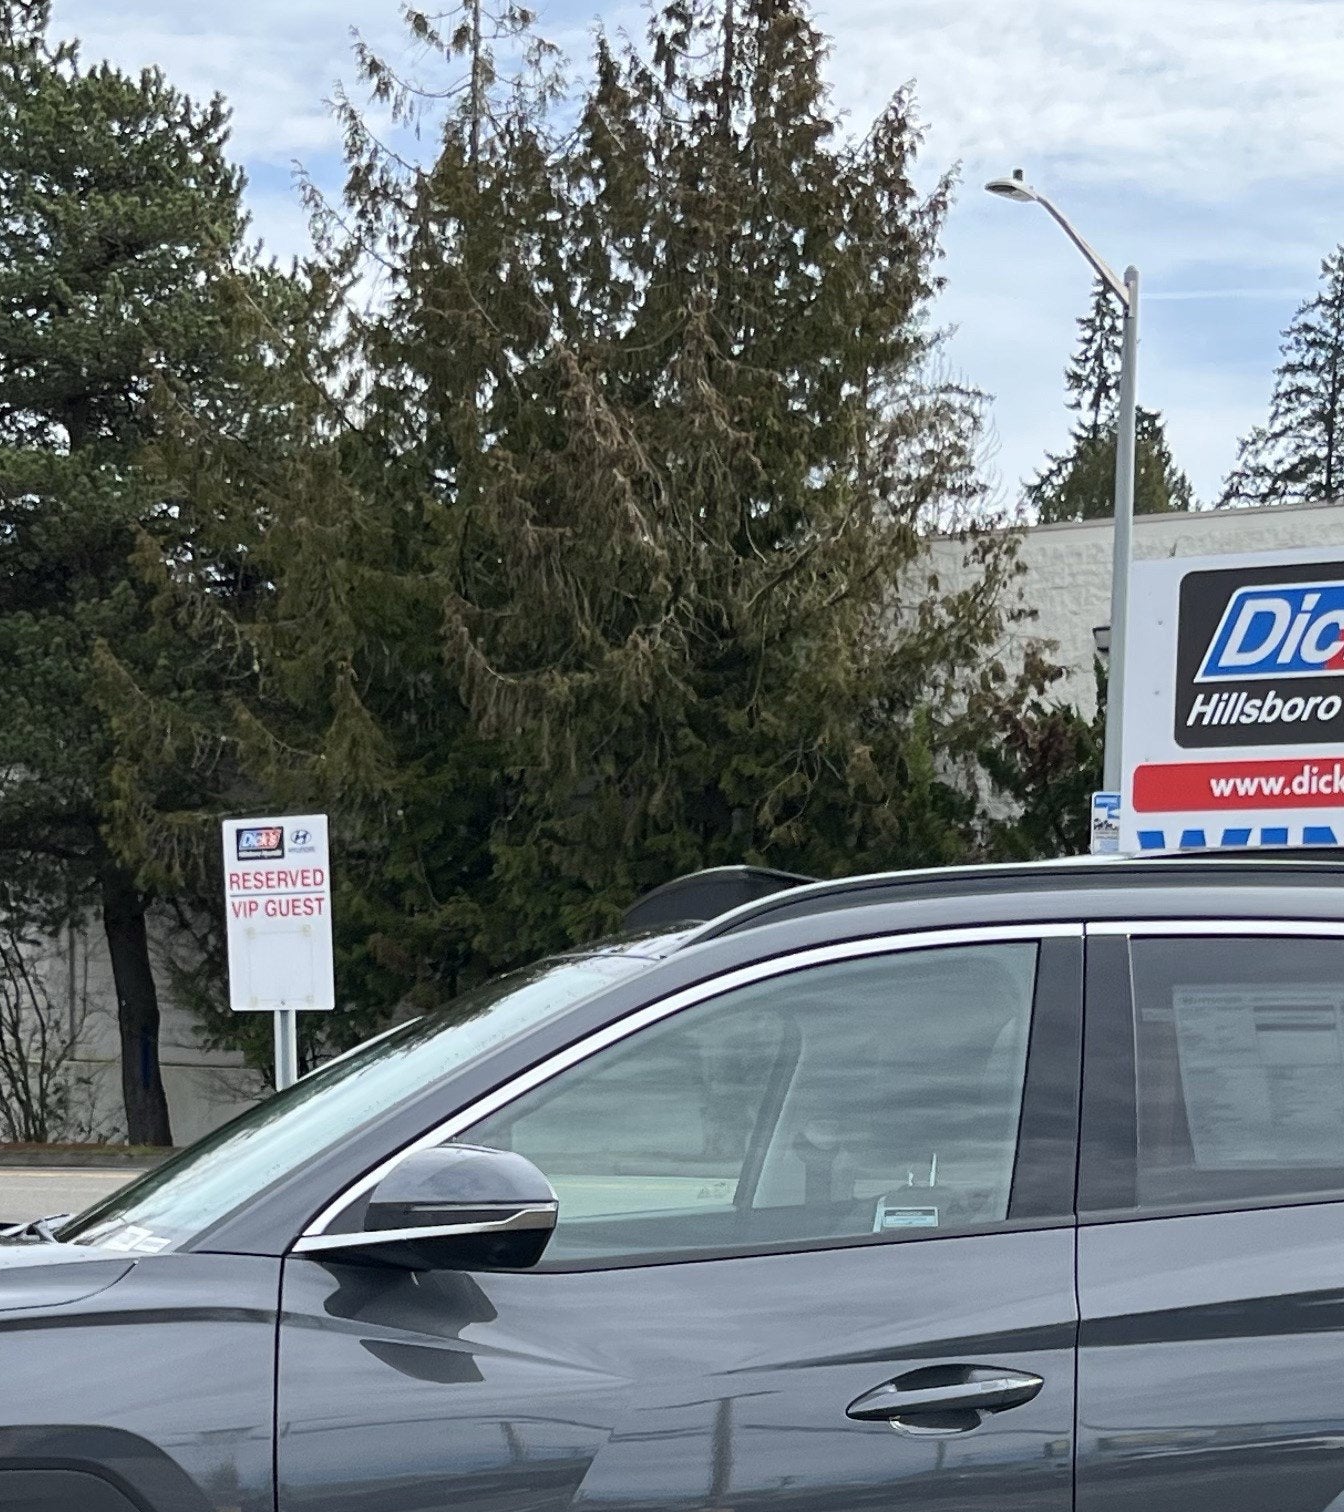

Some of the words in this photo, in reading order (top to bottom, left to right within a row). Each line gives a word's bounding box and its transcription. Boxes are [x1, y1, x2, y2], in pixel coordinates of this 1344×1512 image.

[1186, 690, 1342, 727] Hillsboro
[228, 868, 325, 891] RESERVED
[231, 900, 259, 919] VIP
[264, 897, 325, 918] GUEST
